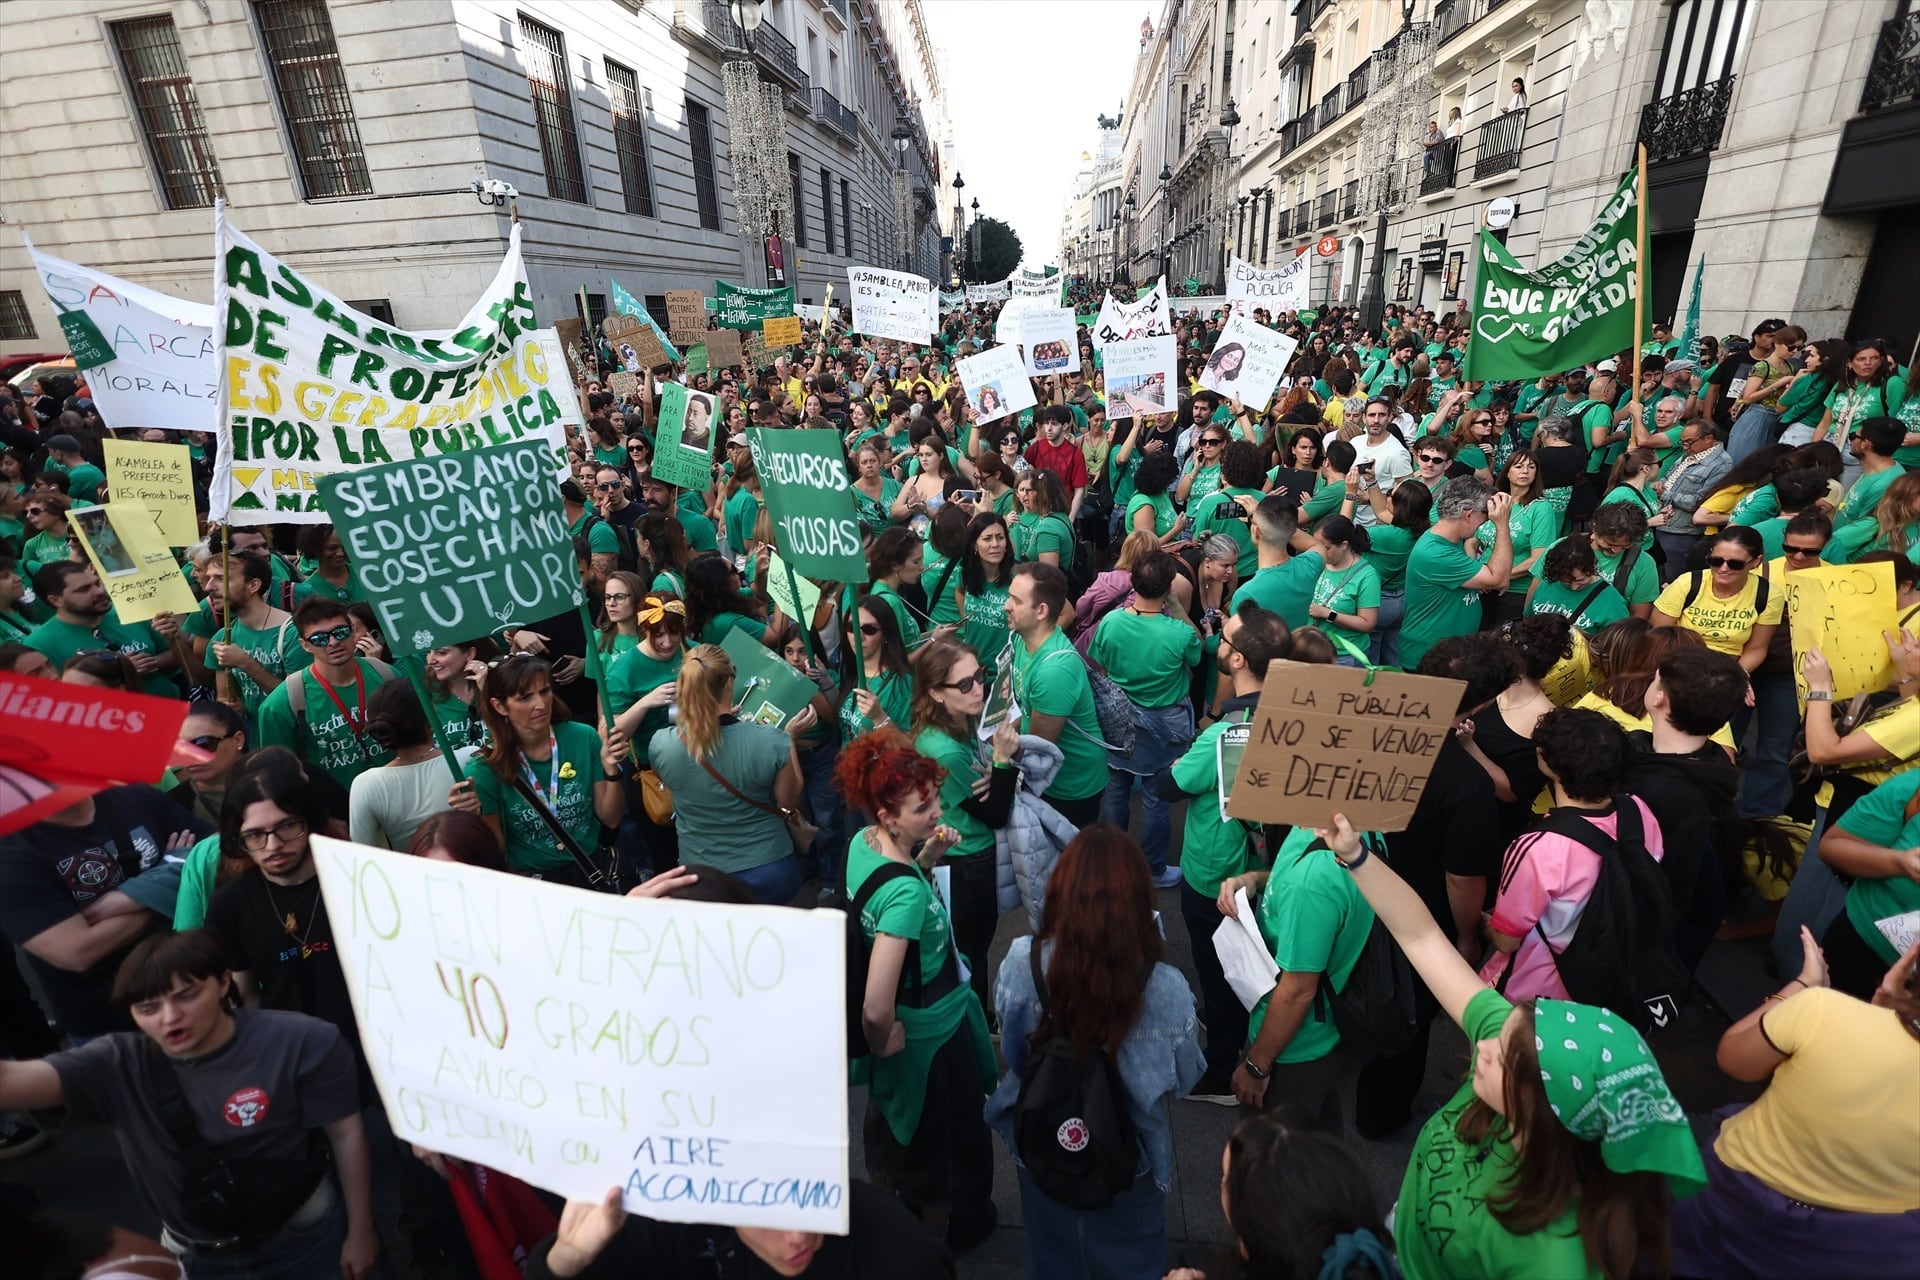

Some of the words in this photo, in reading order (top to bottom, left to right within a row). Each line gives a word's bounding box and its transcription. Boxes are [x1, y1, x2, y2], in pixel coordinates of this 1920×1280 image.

[854, 272, 903, 290] ASAMBLEA
[858, 287, 872, 295] IES
[226, 298, 290, 364] DE
[664, 419, 673, 429] AL
[333, 426, 392, 464] LA
[655, 446, 672, 456] MIS
[115, 457, 165, 469] ASAMBLEA
[171, 460, 183, 470] de
[656, 467, 677, 481] ESTE
[122, 471, 183, 484] PROFESORES
[335, 443, 557, 518] SEMBRAMOS
[116, 487, 135, 499] IES
[136, 488, 167, 500] Gerardo
[1687, 605, 1754, 619] EDUCACIÓN
[1690, 617, 1749, 630] ESPECIAL
[1292, 687, 1316, 707] LA
[1337, 690, 1431, 719] PÚBLICA
[1261, 718, 1304, 746] NO
[1321, 725, 1352, 749] SE
[1372, 725, 1443, 757] VENDE
[1247, 768, 1271, 787] SE
[1284, 754, 1428, 803] DEFIENDE
[334, 853, 400, 940] YO
[424, 873, 503, 965] EN
[534, 896, 785, 999] VERANO
[364, 943, 404, 1022] A
[436, 961, 508, 1049] 40
[535, 996, 713, 1067] GRADOS
[378, 1028, 394, 1074] Y
[575, 1081, 628, 1131] EN
[658, 1090, 716, 1129] SU
[398, 1086, 536, 1164] OFICINA
[633, 1135, 731, 1168] AIRE
